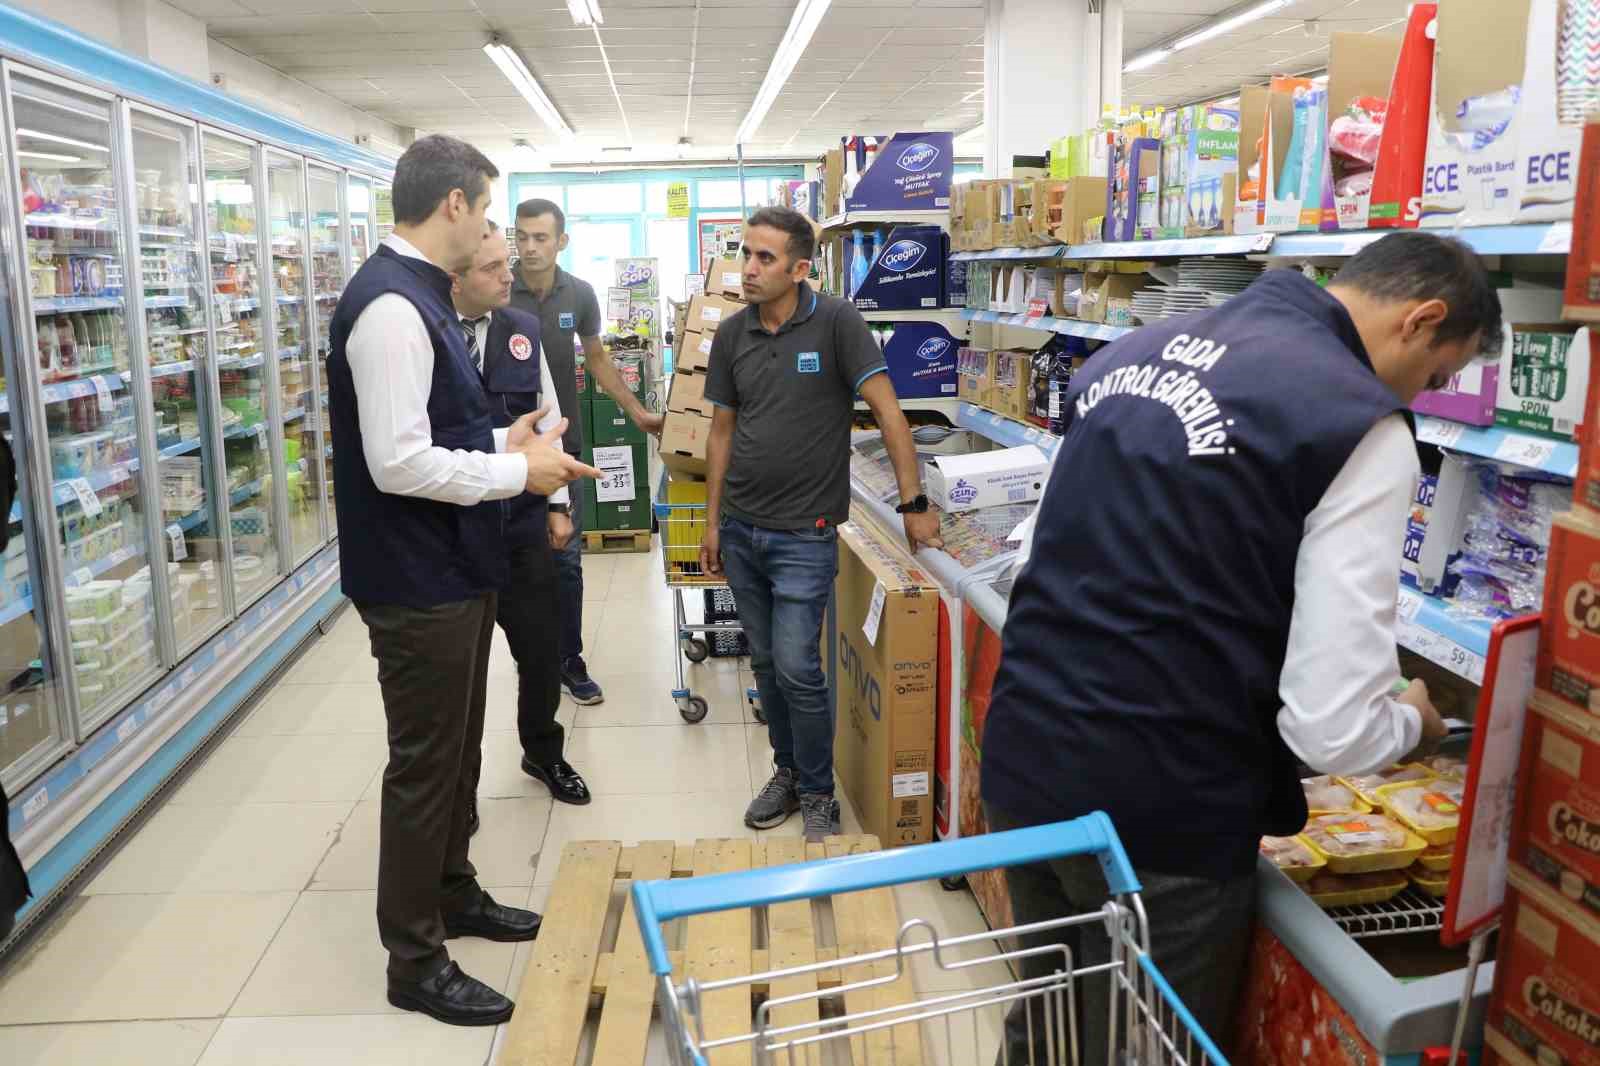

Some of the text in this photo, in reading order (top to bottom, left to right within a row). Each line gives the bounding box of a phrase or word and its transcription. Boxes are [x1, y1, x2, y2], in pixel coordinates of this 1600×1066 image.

[902, 148, 934, 166] Çiçeğim
[1466, 161, 1493, 176] Plastik
[1526, 151, 1571, 185] ECE
[1424, 163, 1459, 194] ECE
[885, 246, 920, 266] Çiçeğim
[1161, 333, 1228, 372] GIDA
[1075, 364, 1160, 419] KONTROL
[1520, 399, 1550, 417] SPON
[1451, 646, 1465, 665] 59
